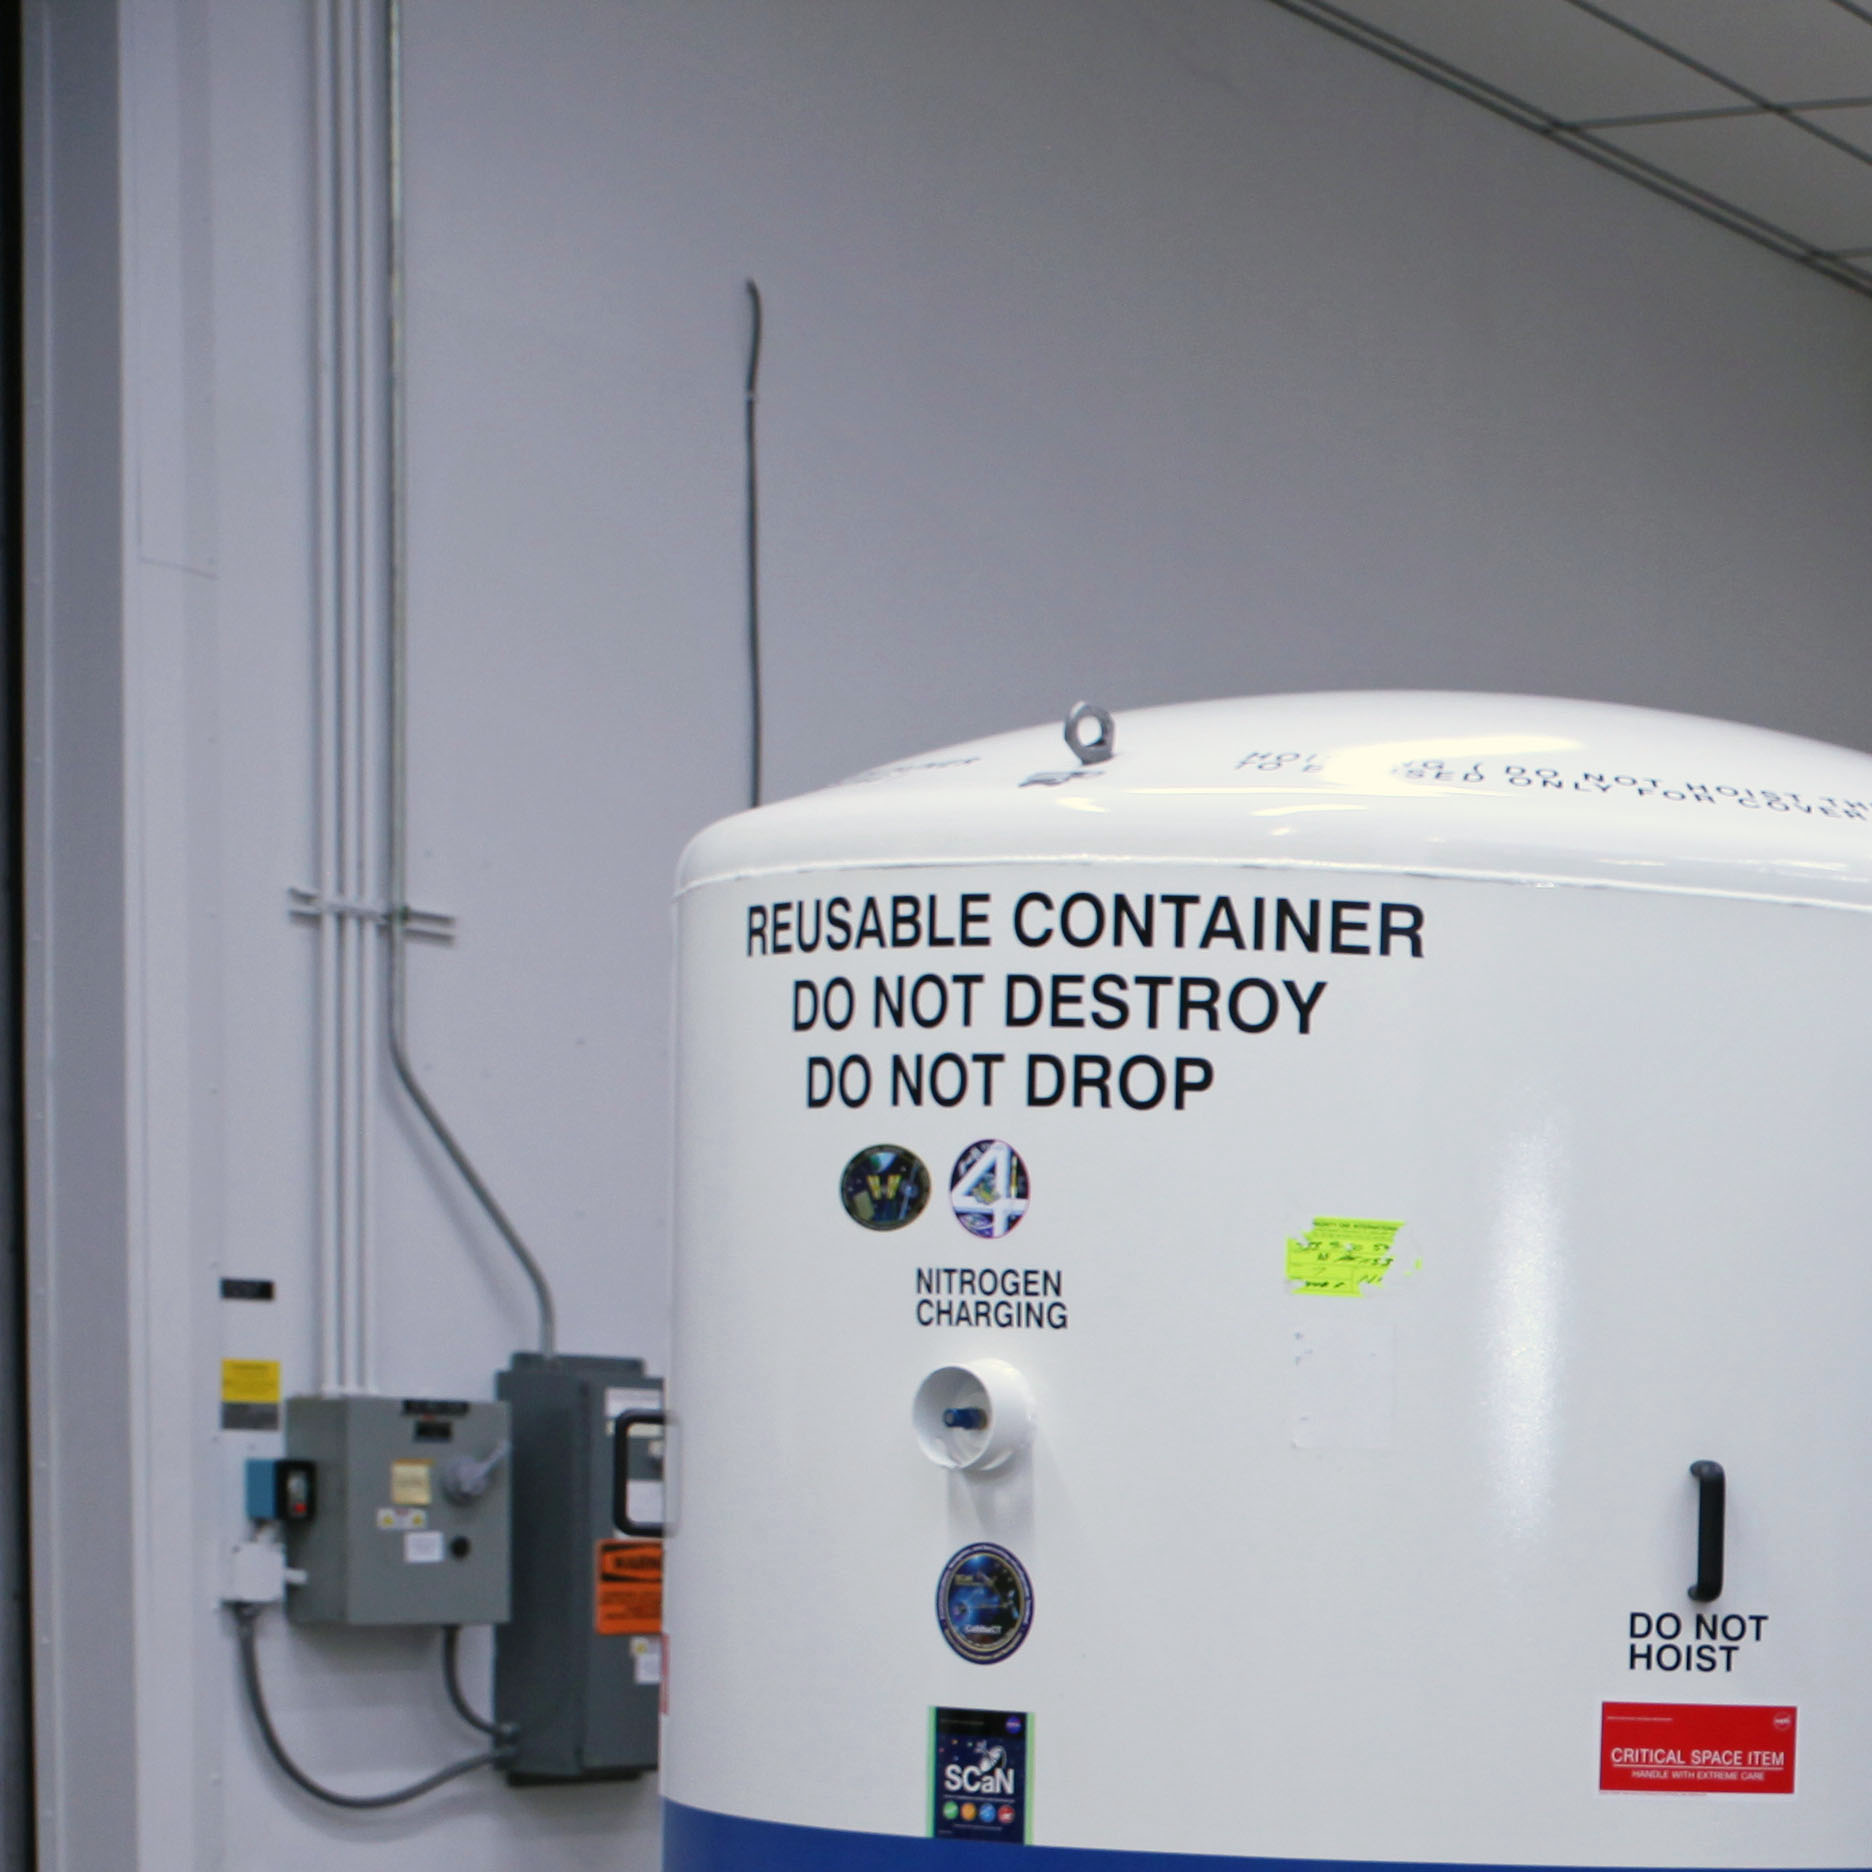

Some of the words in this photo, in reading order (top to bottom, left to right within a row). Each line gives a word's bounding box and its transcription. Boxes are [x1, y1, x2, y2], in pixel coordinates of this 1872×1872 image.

[1505, 765, 1558, 778] DO
[1583, 772, 1661, 788] NOT
[1686, 781, 1800, 802] HOIST
[1509, 776, 1611, 793] ONLY
[1638, 786, 1716, 804] FOR
[746, 892, 992, 957] REUSABLE
[1012, 891, 1426, 959] CONTAINER
[792, 977, 851, 1033] DO
[873, 973, 984, 1029] NOT
[1004, 973, 1328, 1035] DESTROY
[805, 1055, 871, 1109] DO
[891, 1051, 1006, 1108] NOT
[1025, 1054, 1216, 1111] DROP
[915, 1267, 1063, 1298] NITROGEN
[916, 1300, 1069, 1330] CHARGING
[1629, 1612, 1682, 1639] DO
[1695, 1613, 1769, 1642] NOT
[1629, 1643, 1740, 1672] HOIST
[1610, 1747, 1686, 1765] CRITICAL
[1690, 1749, 1743, 1766] SPACE
[1748, 1750, 1785, 1767] ITEM
[944, 1763, 1015, 1795] SCaN
[1631, 1769, 1669, 1780] HANDLE
[1671, 1770, 1696, 1780] WITH
[1696, 1771, 1739, 1781] EXTREME
[1740, 1771, 1766, 1782] CARE
